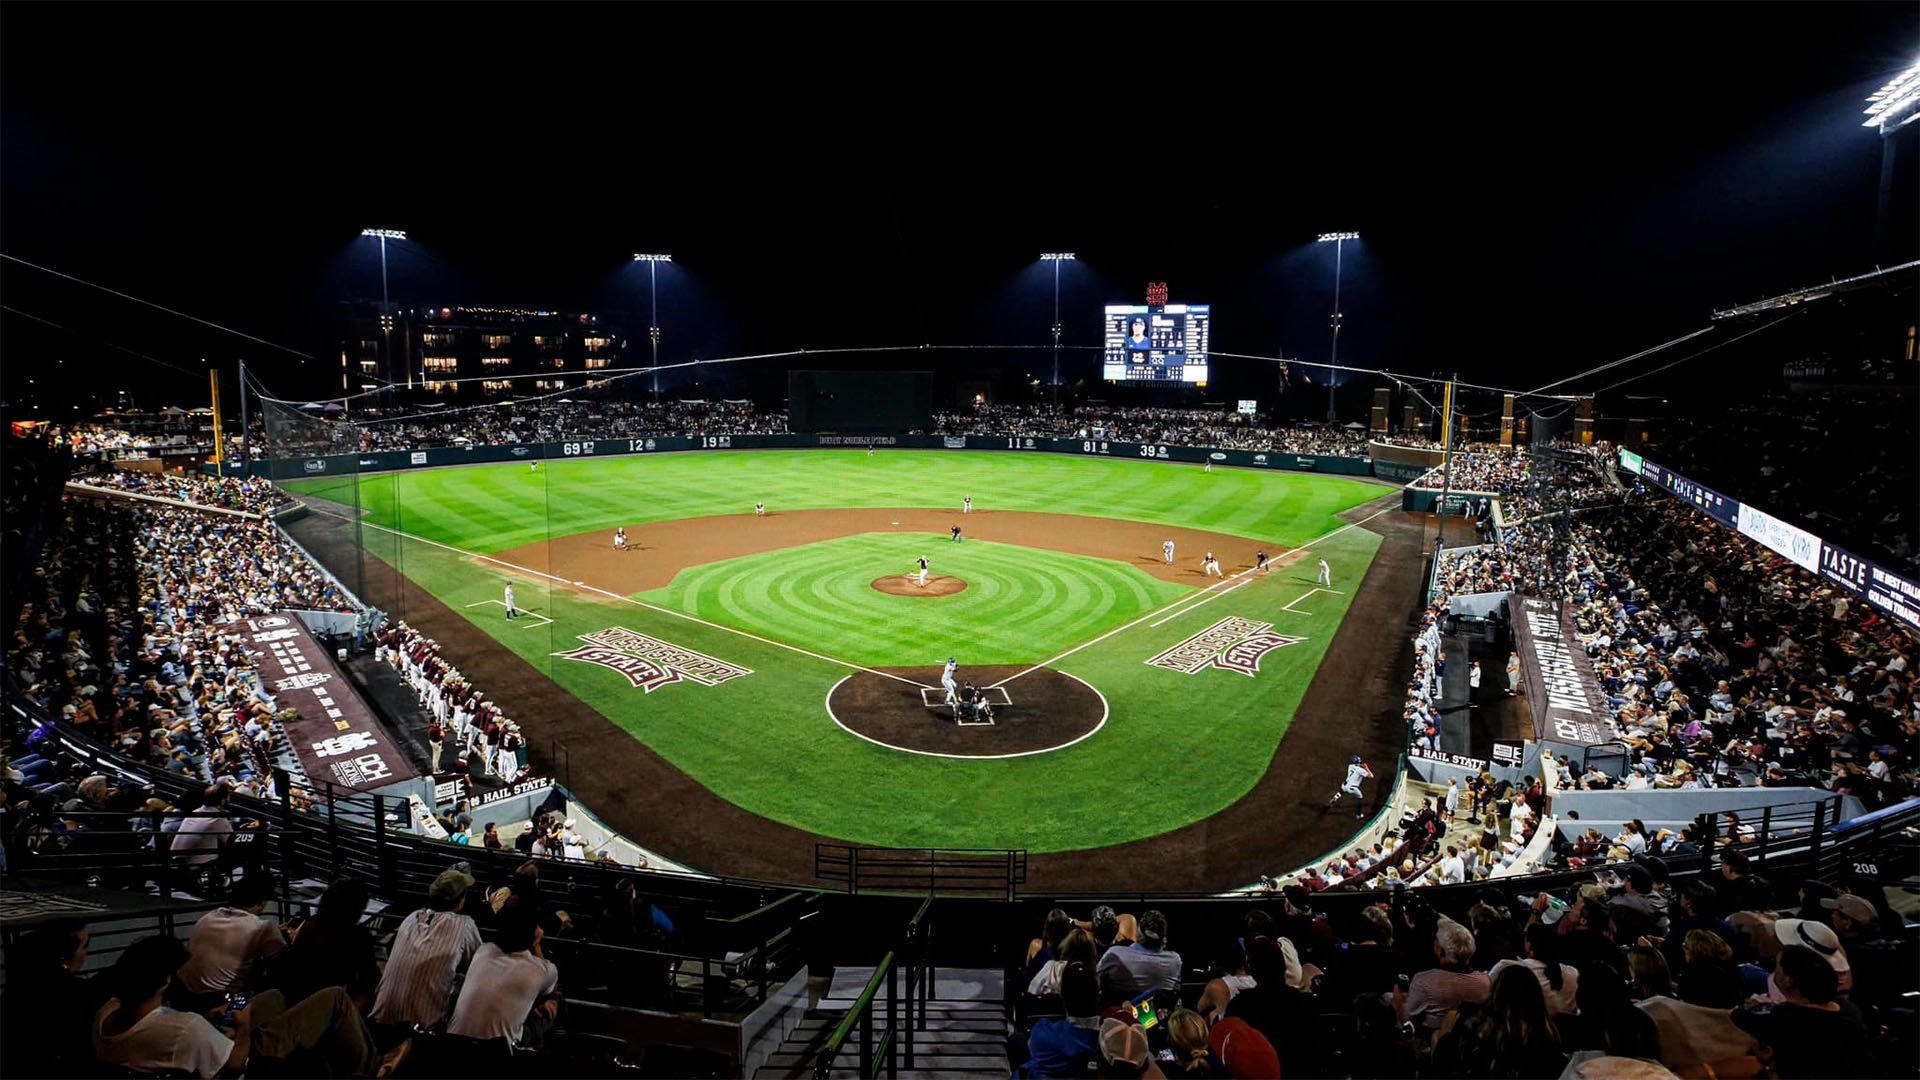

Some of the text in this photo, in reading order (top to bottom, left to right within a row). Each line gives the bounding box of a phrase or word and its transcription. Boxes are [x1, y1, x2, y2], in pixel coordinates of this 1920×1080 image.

[564, 443, 581, 455] 69
[629, 440, 643, 452] 12
[702, 436, 718, 448] 19
[1008, 438, 1021, 448] 11
[1083, 441, 1096, 453] 81
[1140, 445, 1156, 457] 39
[1823, 546, 1866, 584] TASTE
[1526, 611, 1564, 639] STATE
[1154, 617, 1264, 672] MISSISSIPPI
[1228, 638, 1280, 666] STATE
[582, 648, 656, 682] STATE
[591, 629, 746, 684] MISSISSIPPI
[1533, 640, 1592, 714] MISSISSIPPI
[1553, 718, 1580, 740] OCH
[355, 754, 392, 781] OCH
[1424, 749, 1486, 769] HAIL STATE
[484, 778, 547, 803] HAIL STATE
[234, 834, 254, 842] 209
[1853, 863, 1878, 874] 208
